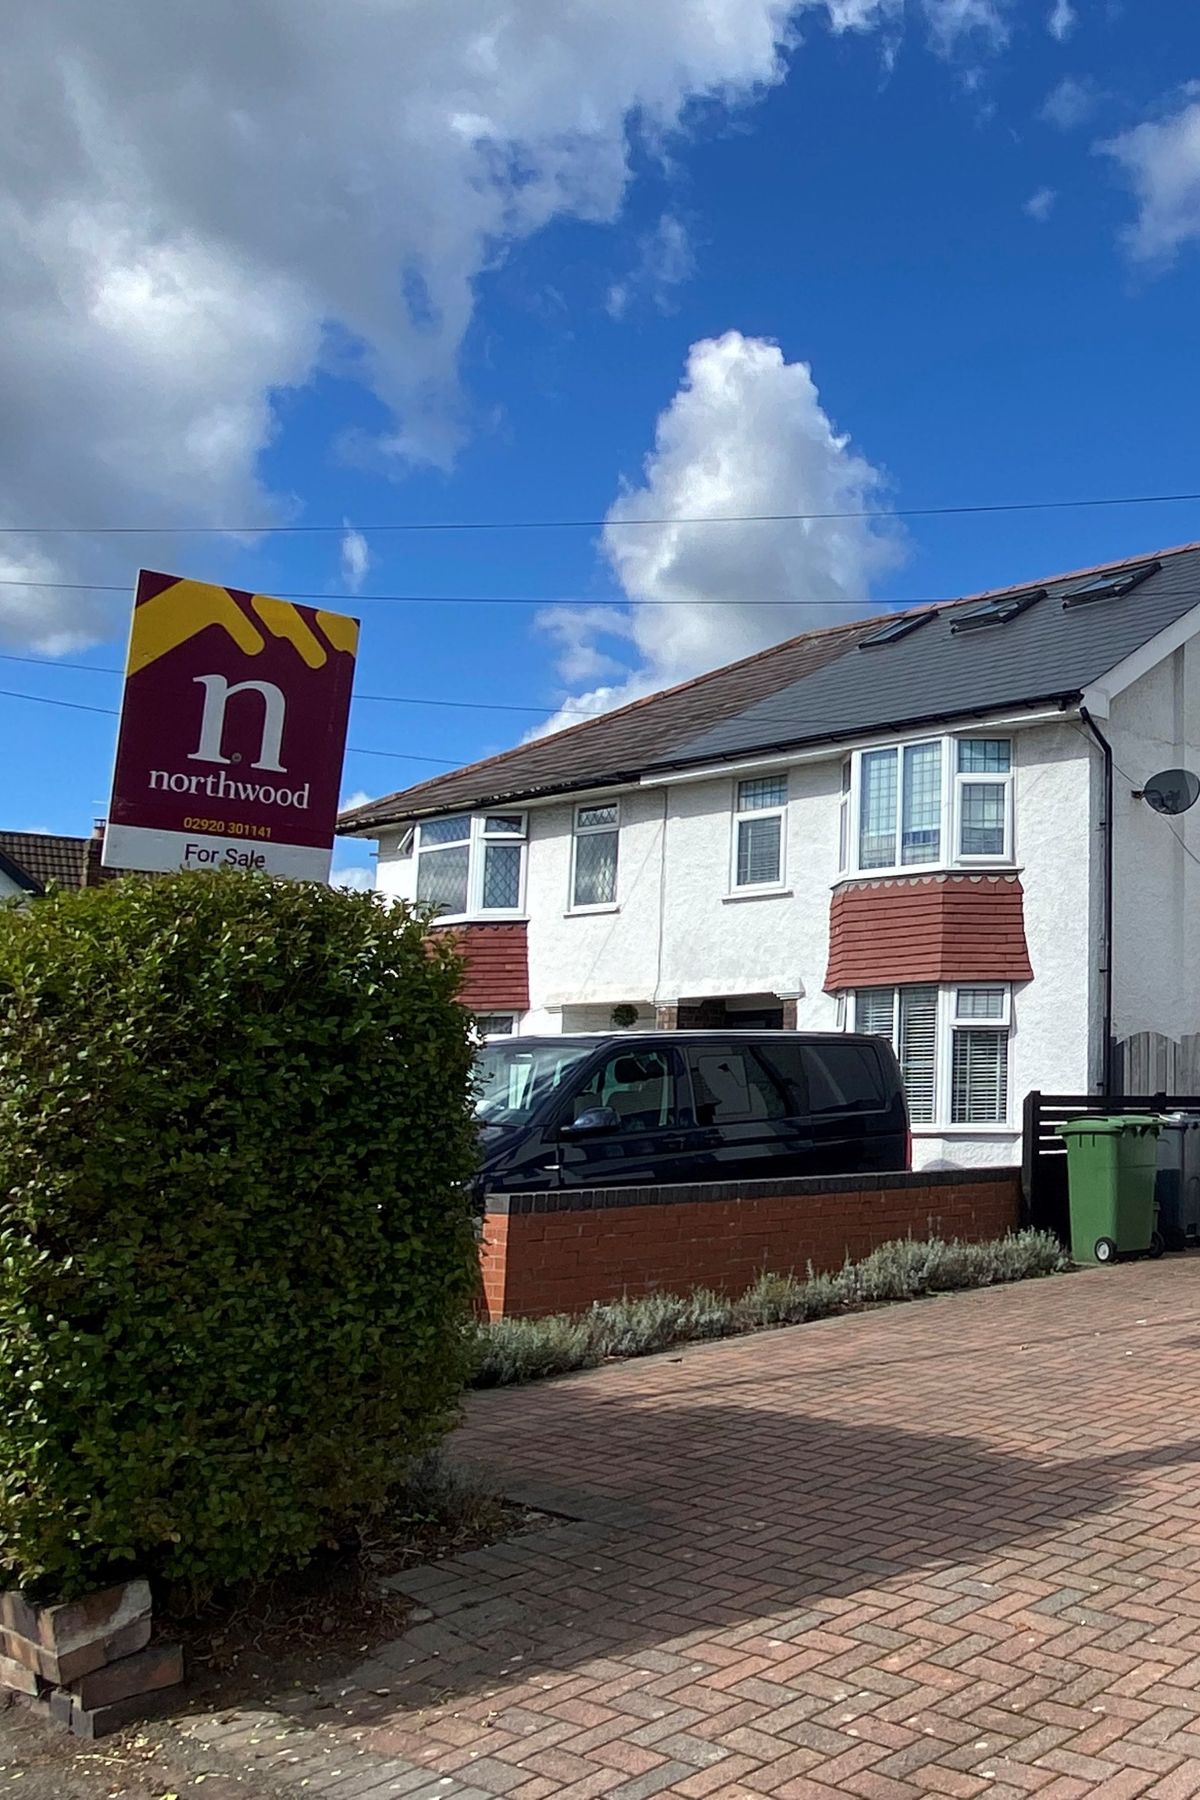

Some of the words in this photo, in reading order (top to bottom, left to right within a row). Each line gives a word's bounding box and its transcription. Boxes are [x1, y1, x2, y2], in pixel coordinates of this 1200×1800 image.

[187, 674, 288, 773] n
[148, 770, 310, 809] northwood
[183, 817, 225, 833] 02920
[227, 822, 272, 838] 301141
[184, 843, 219, 863] For
[224, 848, 266, 869] Sale
